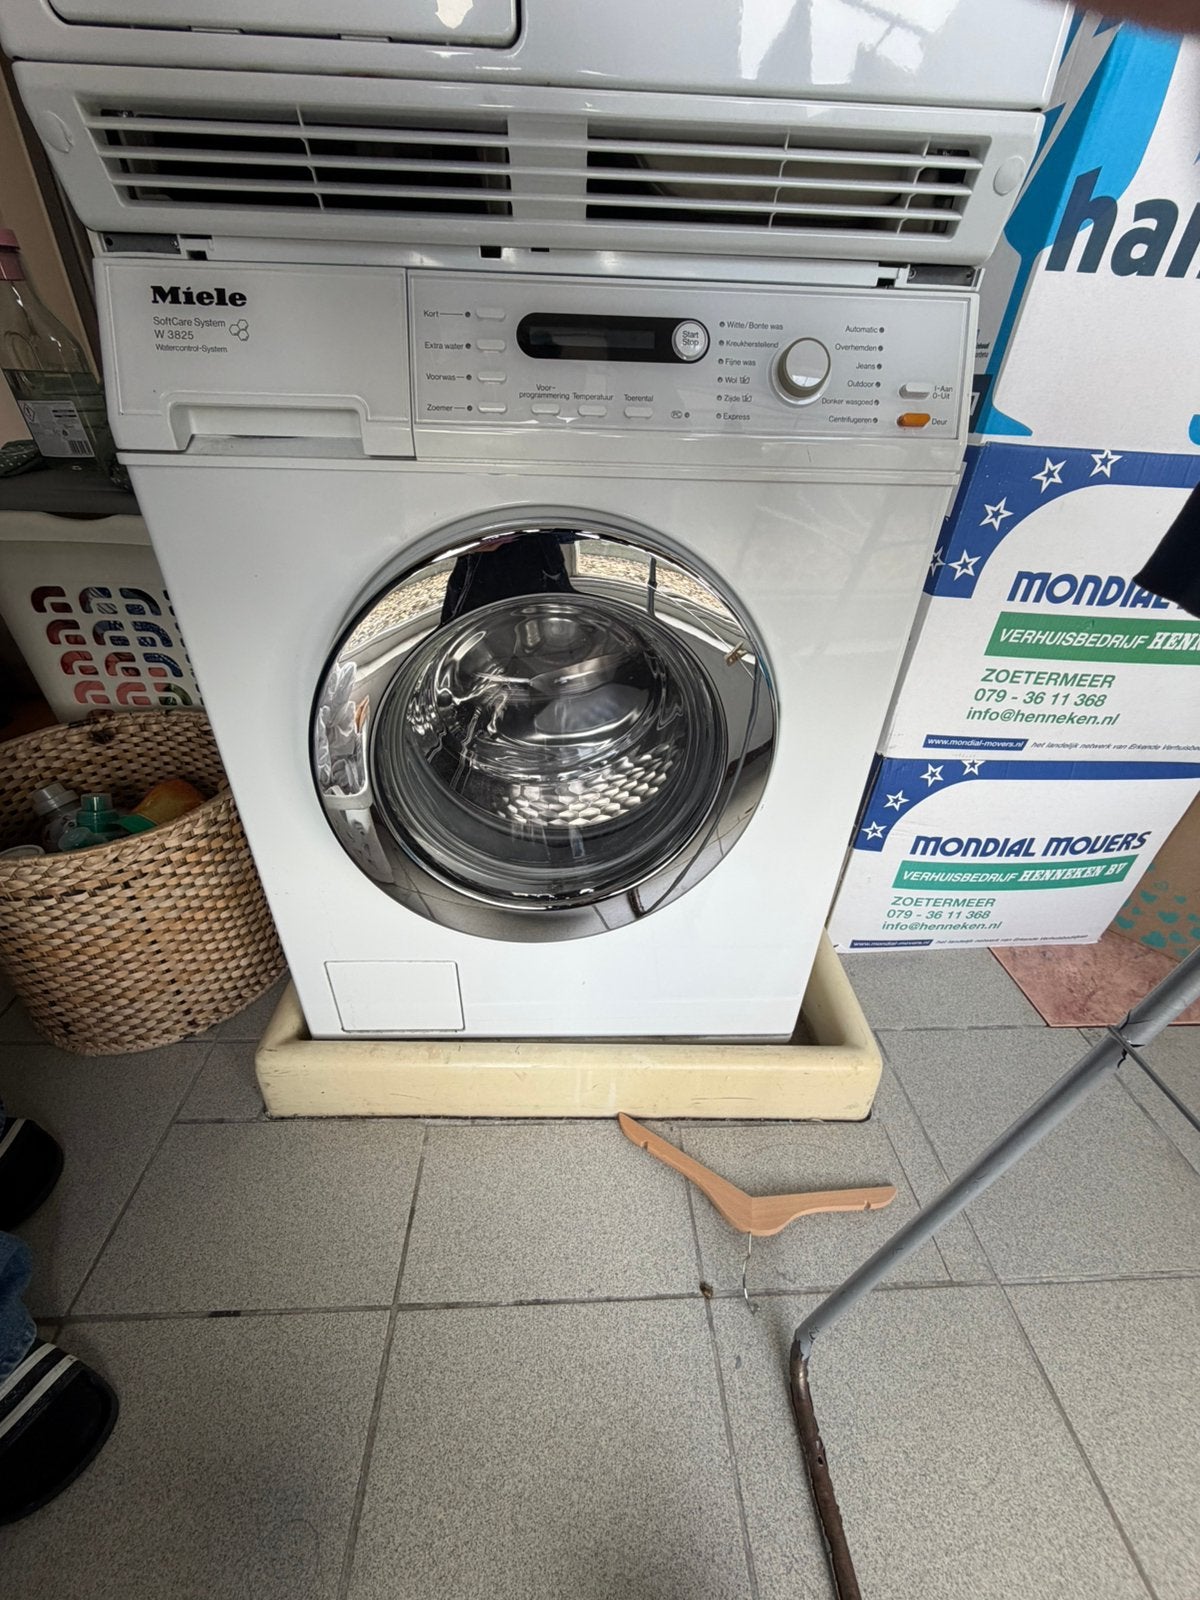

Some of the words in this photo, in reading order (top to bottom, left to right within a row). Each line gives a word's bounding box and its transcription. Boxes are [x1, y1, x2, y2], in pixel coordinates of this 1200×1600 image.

[150, 285, 247, 307] Miele
[423, 309, 439, 318] Kort
[153, 316, 192, 327] SoftCare
[194, 317, 226, 328] System
[845, 325, 878, 333] Automatic
[154, 329, 165, 339] W
[167, 330, 194, 340] 3825
[682, 331, 699, 339] Start
[424, 341, 443, 350] Extra
[444, 342, 464, 350] water
[682, 339, 699, 347] Stop
[726, 340, 779, 348] Kreukherstellend
[835, 343, 877, 352] Overhemden
[155, 343, 228, 353] Watercontrol-System
[725, 358, 741, 366] Fijne
[856, 362, 876, 370] Jeans
[426, 373, 456, 381] Voorwas
[725, 376, 738, 384] Wol
[847, 380, 874, 388] Outdoor
[519, 391, 570, 400] programmering
[572, 392, 614, 401] Temperatuur
[624, 393, 654, 402] Toerental
[724, 394, 740, 403] Zijde
[821, 397, 844, 405] Donker
[845, 398, 873, 406] wasgoed
[427, 403, 453, 412] Zoemer
[723, 412, 750, 421] Express
[828, 415, 872, 424] Centrifugeren
[1000, 628, 1149, 649] VERHUISBEDRIJF
[980, 668, 1116, 689] ZOETERMEER
[974, 688, 1007, 703] 079
[1023, 691, 1046, 705] 36
[1051, 692, 1070, 706] 11
[1073, 694, 1107, 708] 368
[966, 706, 1121, 726] info@henneken.nl
[927, 736, 1025, 748] www.mondial-movers.nl
[909, 835, 1036, 857] MONDIAL
[1041, 831, 1152, 857] MOVERS
[902, 870, 1019, 883] VERHUISBEDRIJF
[1017, 865, 1105, 882] HENNEKEN
[1105, 862, 1128, 876] BV
[891, 896, 996, 907] ZOETERMEER
[886, 909, 913, 919] 079
[925, 910, 943, 920] 36
[948, 911, 962, 919] 11
[965, 910, 991, 920] 368
[882, 921, 1003, 931] info@henneken.nl
